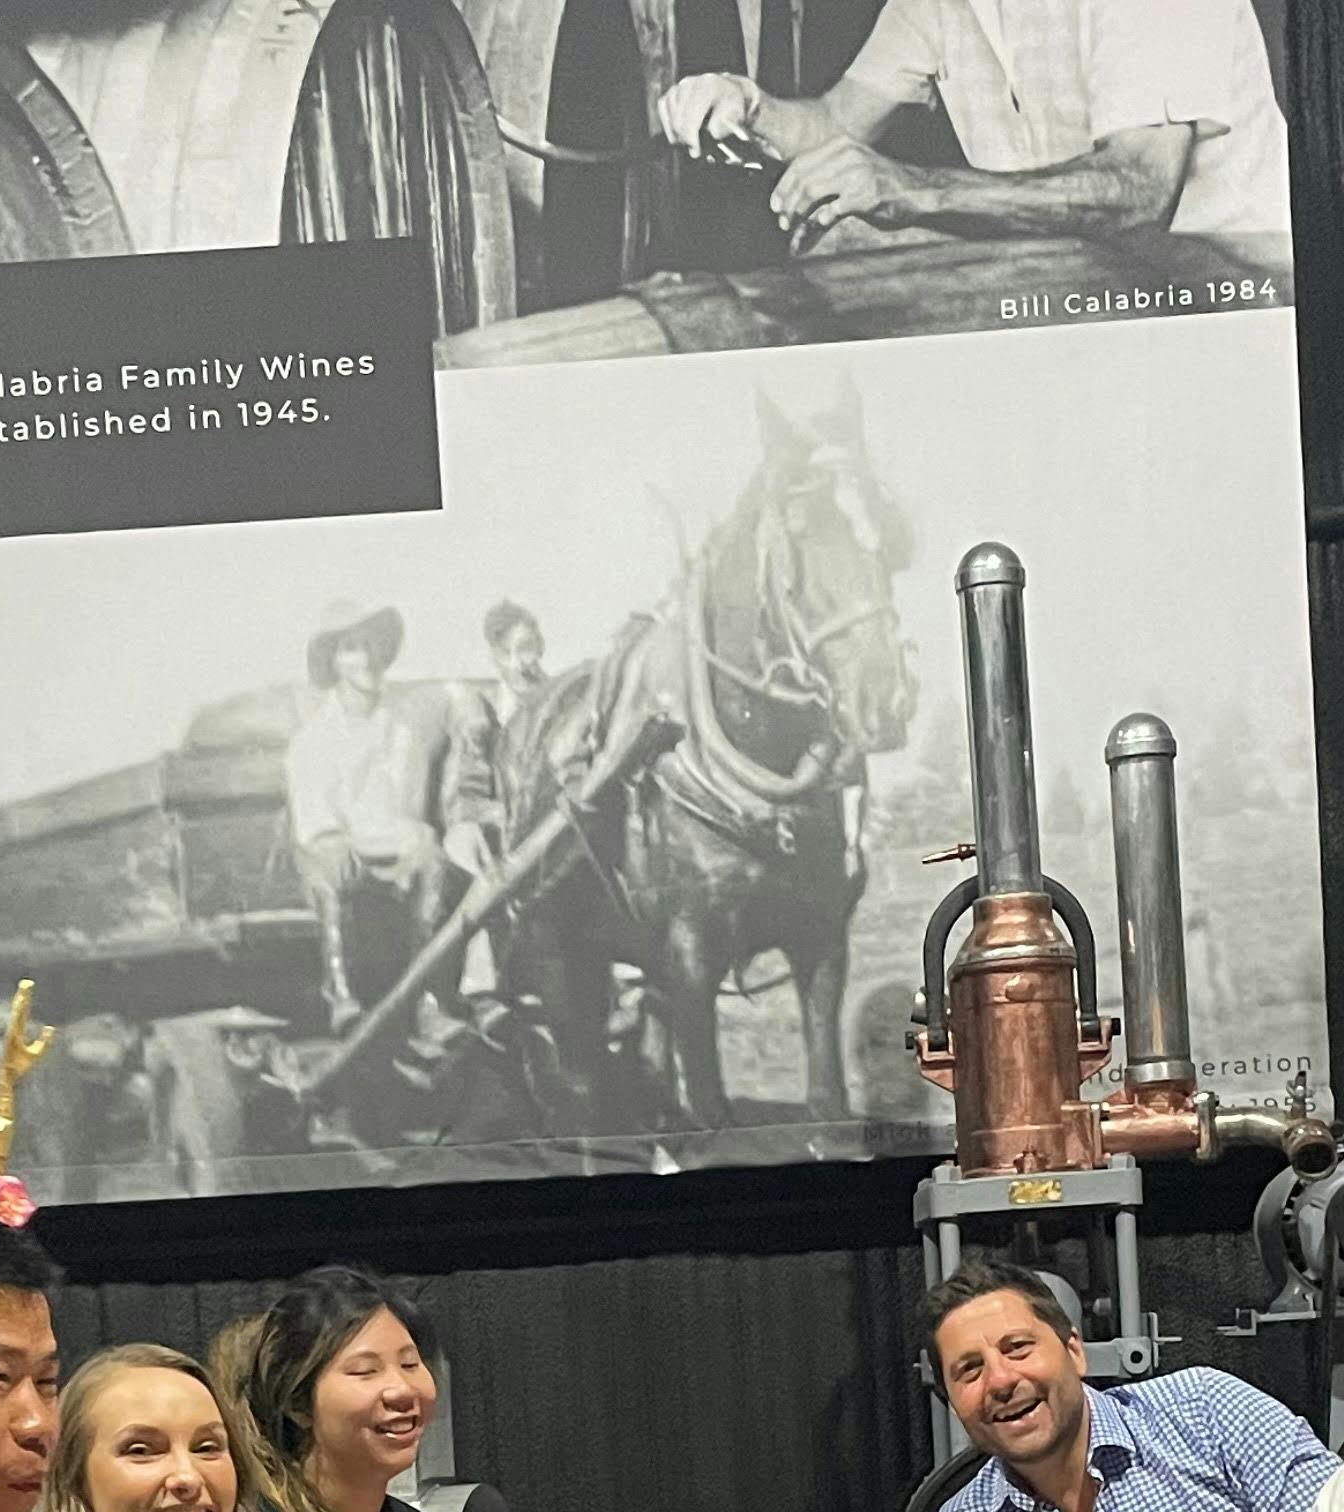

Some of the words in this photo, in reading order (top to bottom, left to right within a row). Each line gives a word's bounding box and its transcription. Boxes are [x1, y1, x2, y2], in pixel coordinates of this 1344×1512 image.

[1000, 294, 1050, 319] Bill
[1064, 284, 1193, 314] Calabria
[1206, 278, 1276, 302] 1984
[120, 359, 244, 390] Family
[260, 352, 376, 380] Wines
[188, 404, 222, 431] in
[237, 397, 331, 427] 1945.
[1201, 1053, 1312, 1076] eration
